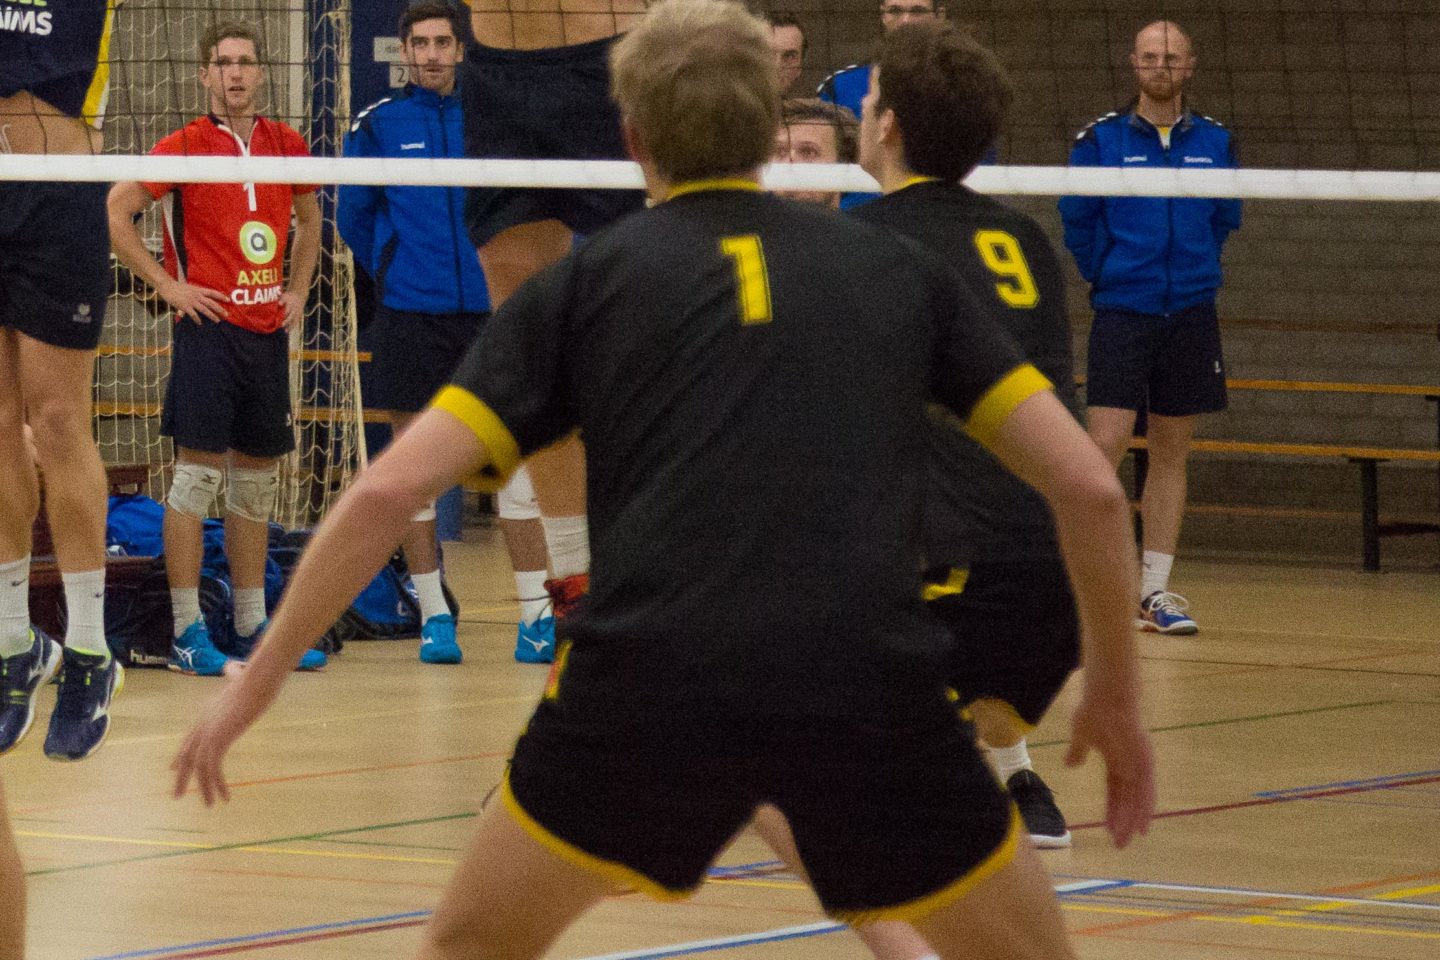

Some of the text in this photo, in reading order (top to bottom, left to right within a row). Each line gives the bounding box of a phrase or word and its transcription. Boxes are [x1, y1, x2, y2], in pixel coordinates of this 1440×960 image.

[397, 67, 406, 83] 2
[243, 182, 257, 212] 1
[720, 235, 773, 324] 1
[974, 229, 1039, 308] 9
